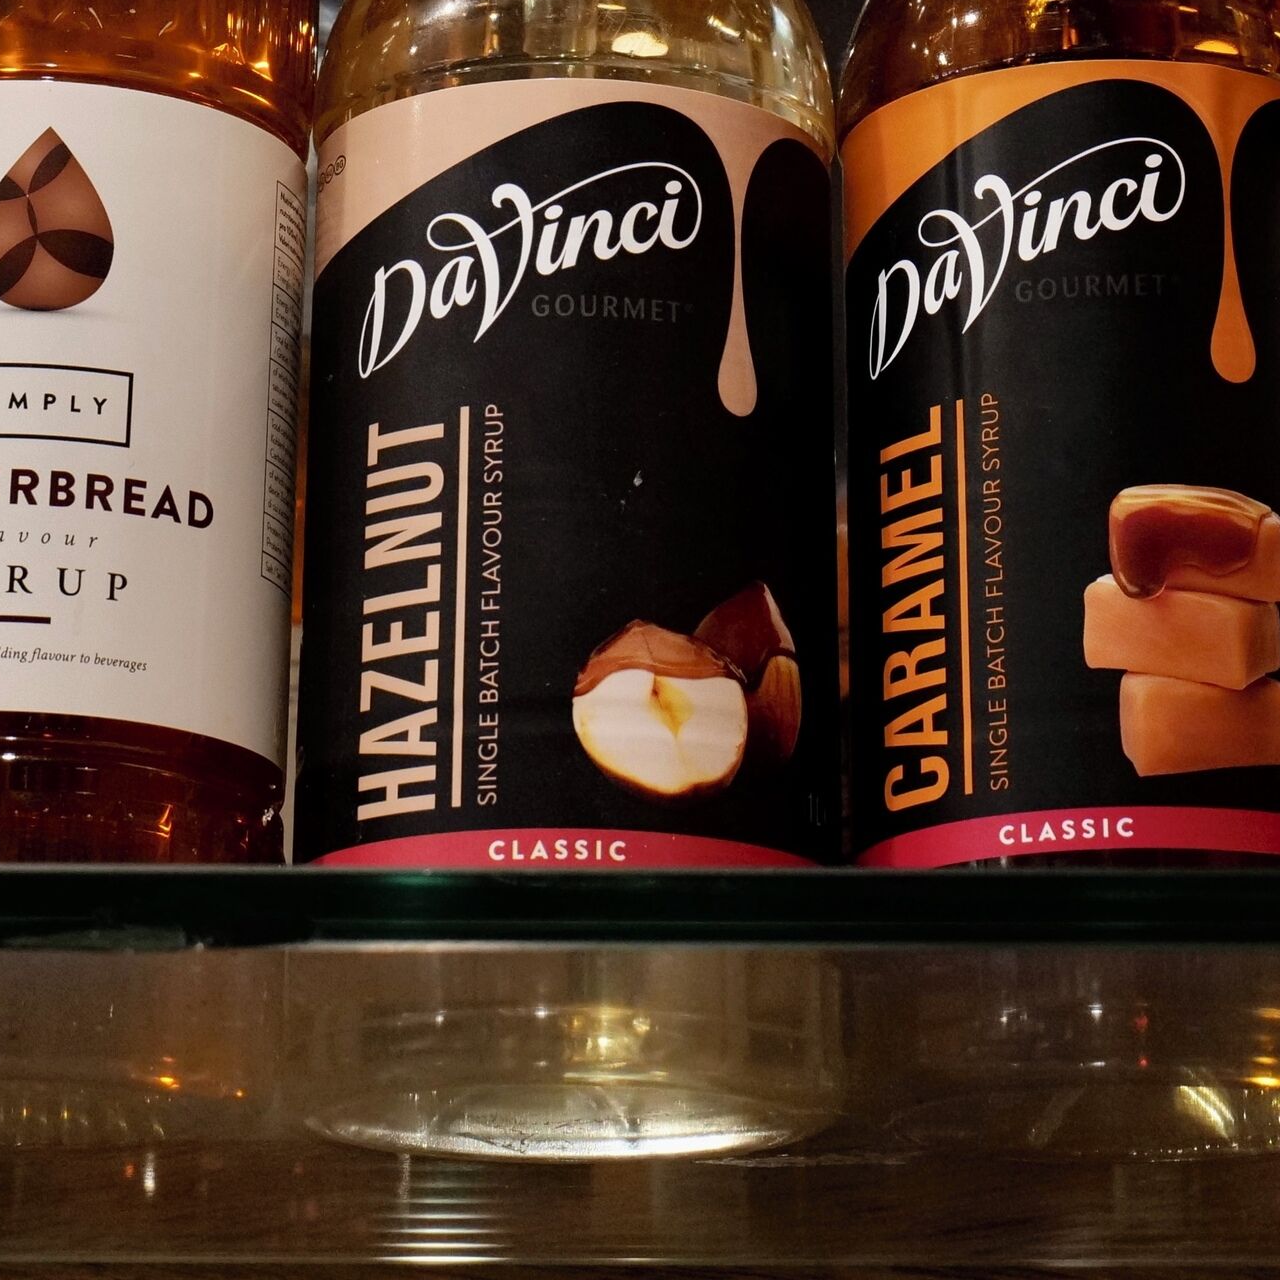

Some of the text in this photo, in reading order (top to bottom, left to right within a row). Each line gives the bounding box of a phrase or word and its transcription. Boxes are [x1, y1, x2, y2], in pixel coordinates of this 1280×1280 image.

[357, 160, 704, 380] DaVinci
[531, 292, 681, 324] GOURMET
[869, 136, 1187, 382] DaVinci
[1014, 272, 1168, 304] GOURMET
[28, 647, 76, 664] flavour
[79, 652, 91, 664] to
[93, 653, 148, 673] beverages
[356, 421, 446, 824] HAZELNUT
[477, 402, 505, 807] SINGLE BATCH FLAVOUR SYRUP
[880, 403, 953, 814] CARAMEL
[980, 391, 1010, 791] SINGLE BATCH FLAVOUR SYRUP
[487, 837, 629, 865] CLASSIC
[998, 816, 1136, 847] CLASSIC
